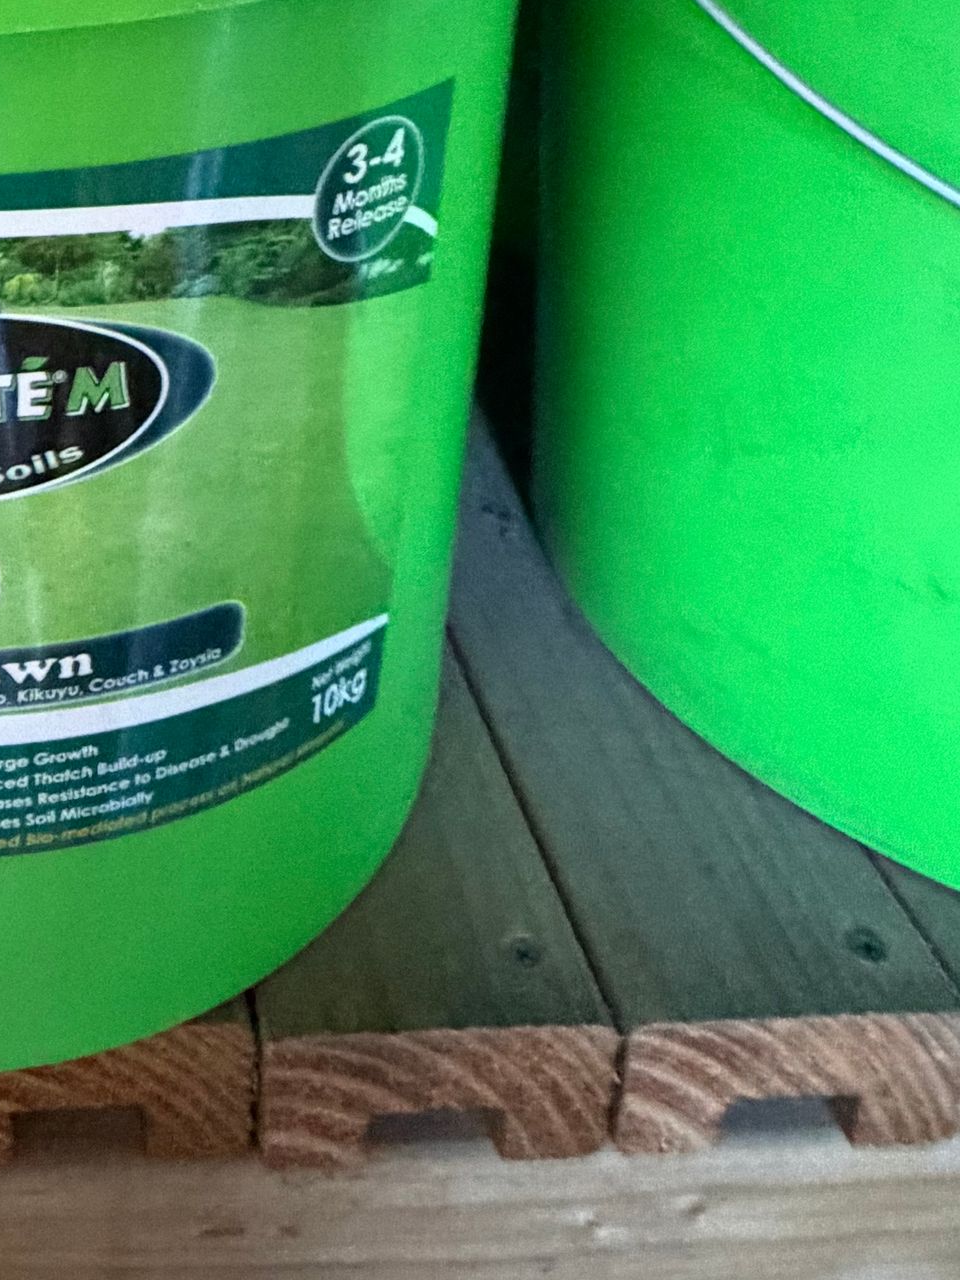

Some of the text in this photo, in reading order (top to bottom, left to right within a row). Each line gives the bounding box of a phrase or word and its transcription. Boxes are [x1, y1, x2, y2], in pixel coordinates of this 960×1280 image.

[343, 126, 405, 184] 3-4
[332, 173, 408, 215] Months
[327, 196, 408, 240] Release
[88, 670, 150, 693] Couch
[153, 664, 164, 678] &
[169, 648, 223, 673] Zoysia
[311, 668, 368, 724] 10kg
[33, 744, 99, 766] Growth
[34, 766, 93, 786] Thatch
[96, 748, 168, 775] Build-up
[38, 779, 131, 806] Resistance
[134, 773, 151, 786] to
[155, 751, 217, 780] Disease
[219, 744, 231, 758] &
[234, 717, 290, 752] Drought
[25, 811, 56, 827] Soil
